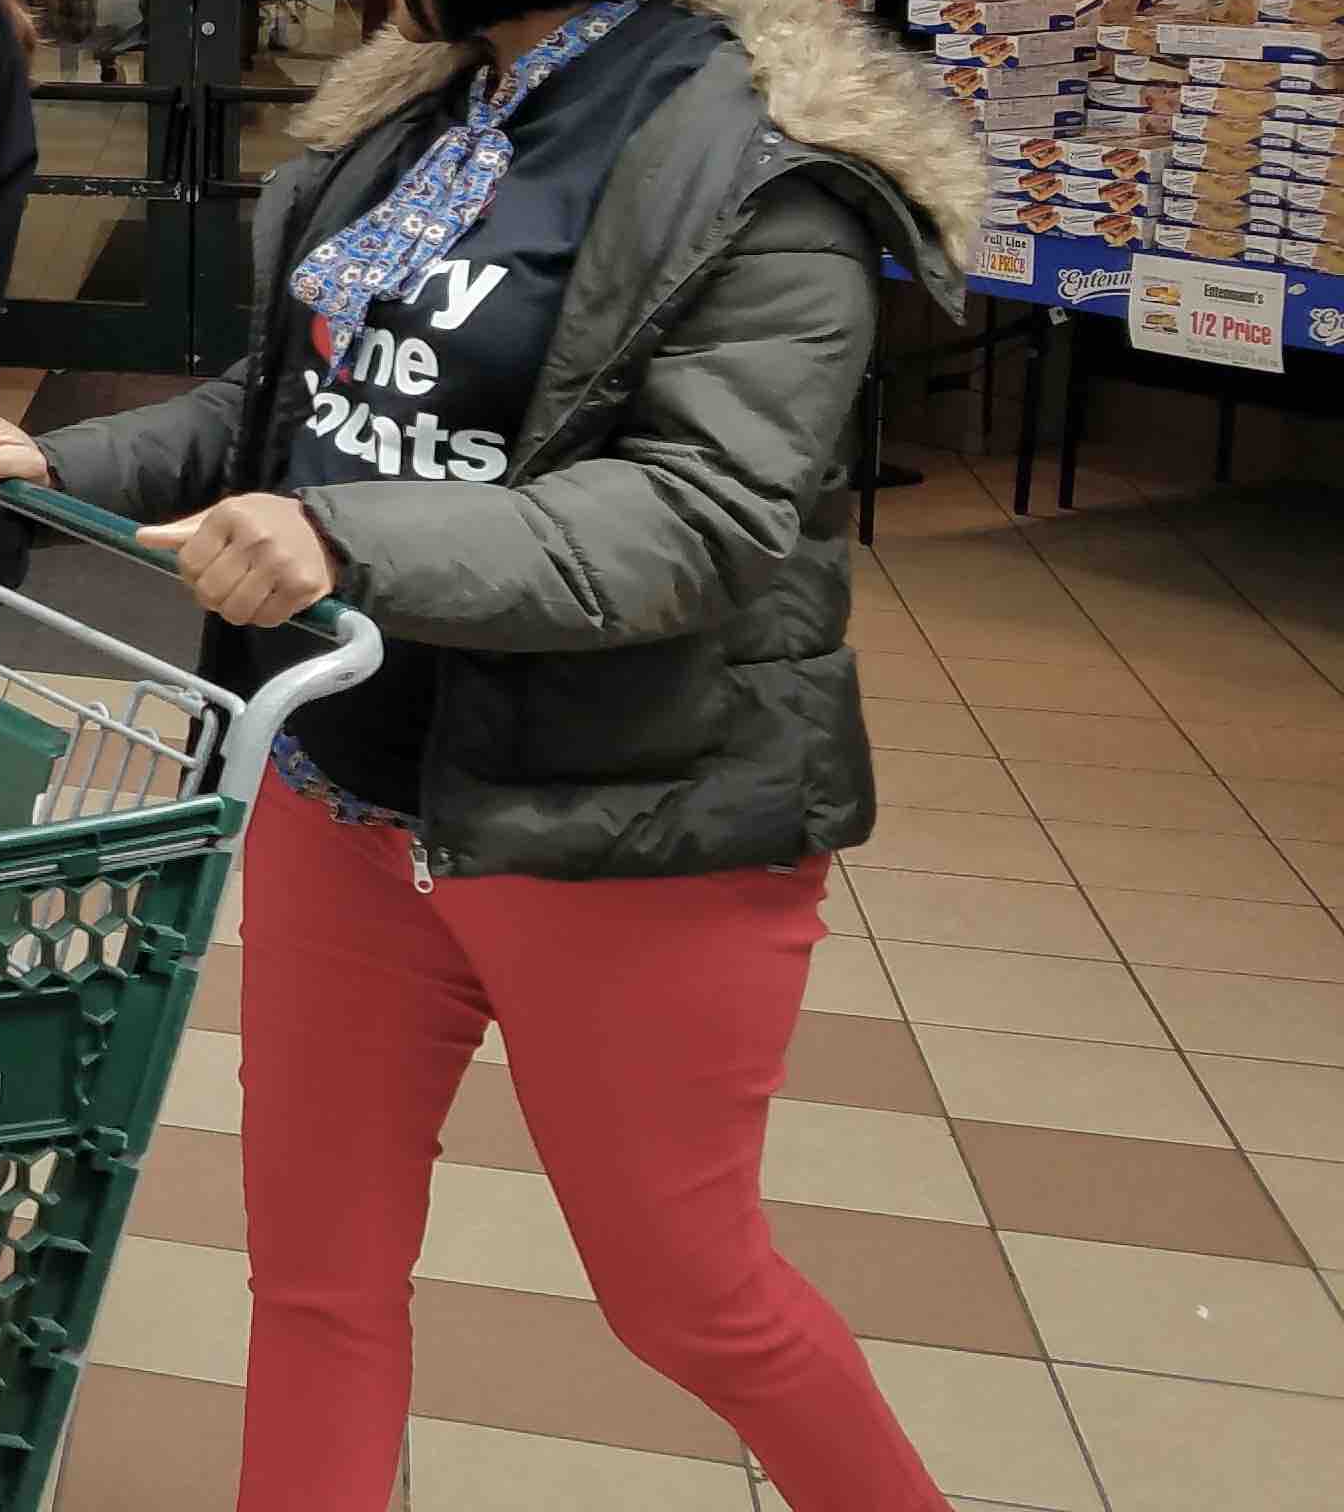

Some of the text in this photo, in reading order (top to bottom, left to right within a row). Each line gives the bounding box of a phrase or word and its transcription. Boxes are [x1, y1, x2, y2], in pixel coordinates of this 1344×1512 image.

[1006, 237, 1027, 248] Line
[1190, 311, 1272, 346] 1/2 Price
